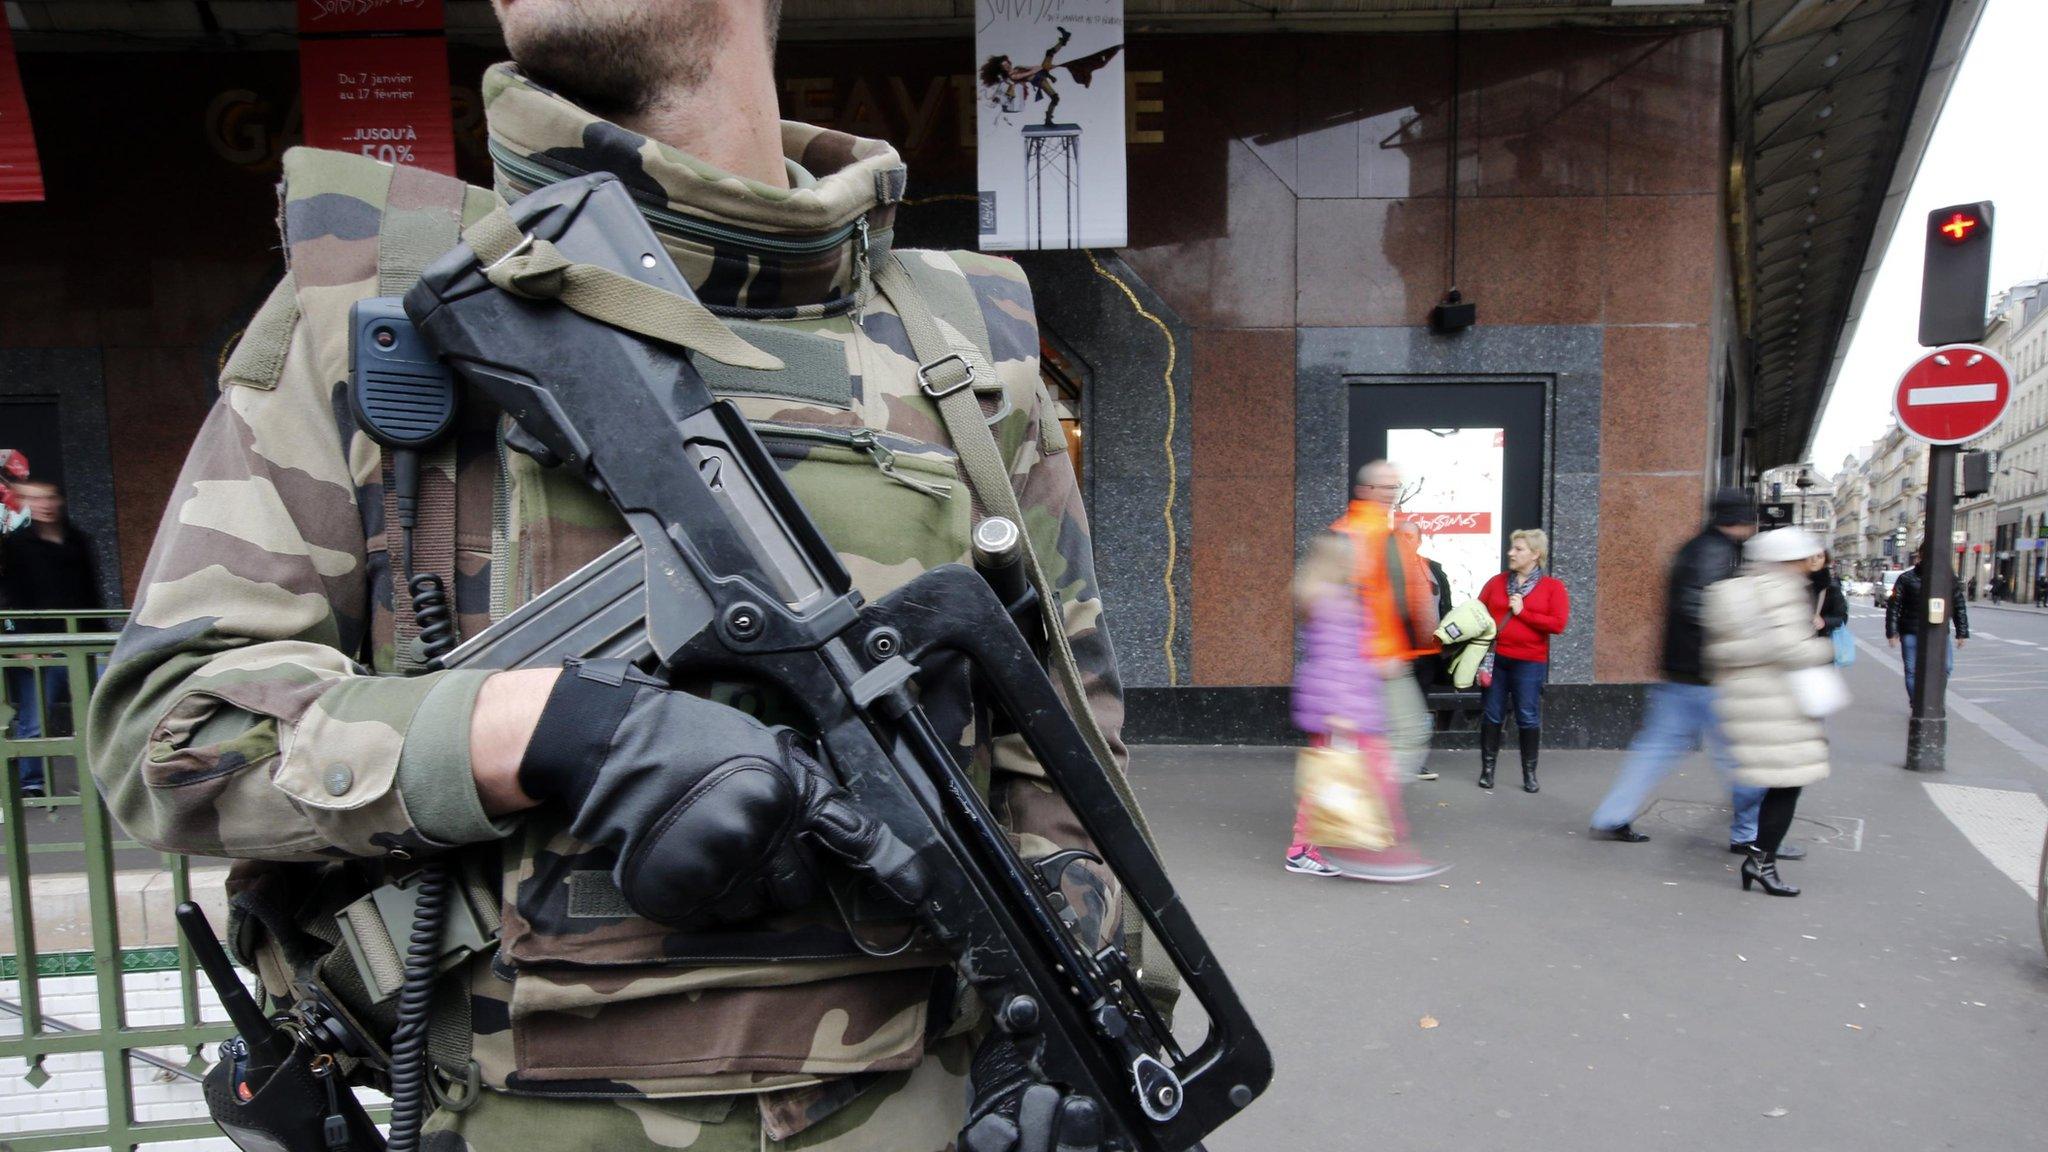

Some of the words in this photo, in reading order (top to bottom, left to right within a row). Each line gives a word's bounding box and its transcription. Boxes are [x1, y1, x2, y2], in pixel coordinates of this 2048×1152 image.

[338, 73, 356, 85] Du
[359, 73, 368, 84] 7
[371, 72, 414, 86] janvier
[339, 91, 355, 101] au
[358, 89, 370, 100] 17
